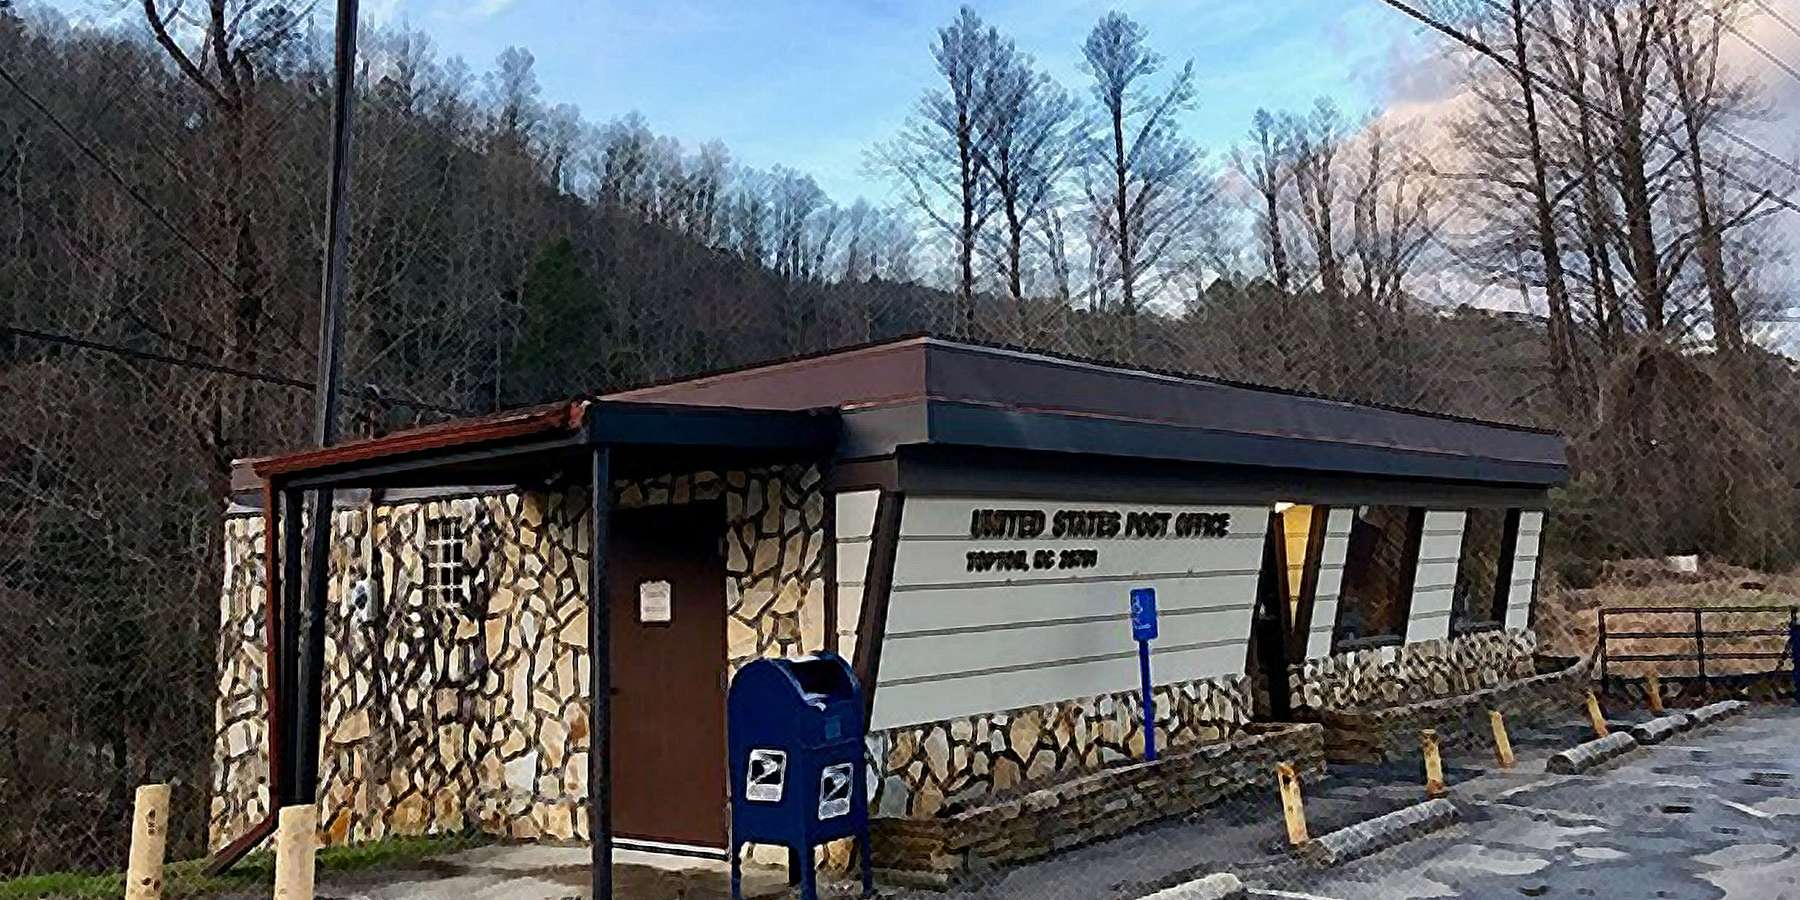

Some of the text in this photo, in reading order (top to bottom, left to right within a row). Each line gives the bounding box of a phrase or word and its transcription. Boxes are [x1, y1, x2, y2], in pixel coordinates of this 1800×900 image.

[970, 509, 1231, 538] UNITED STATES POST OFFICE
